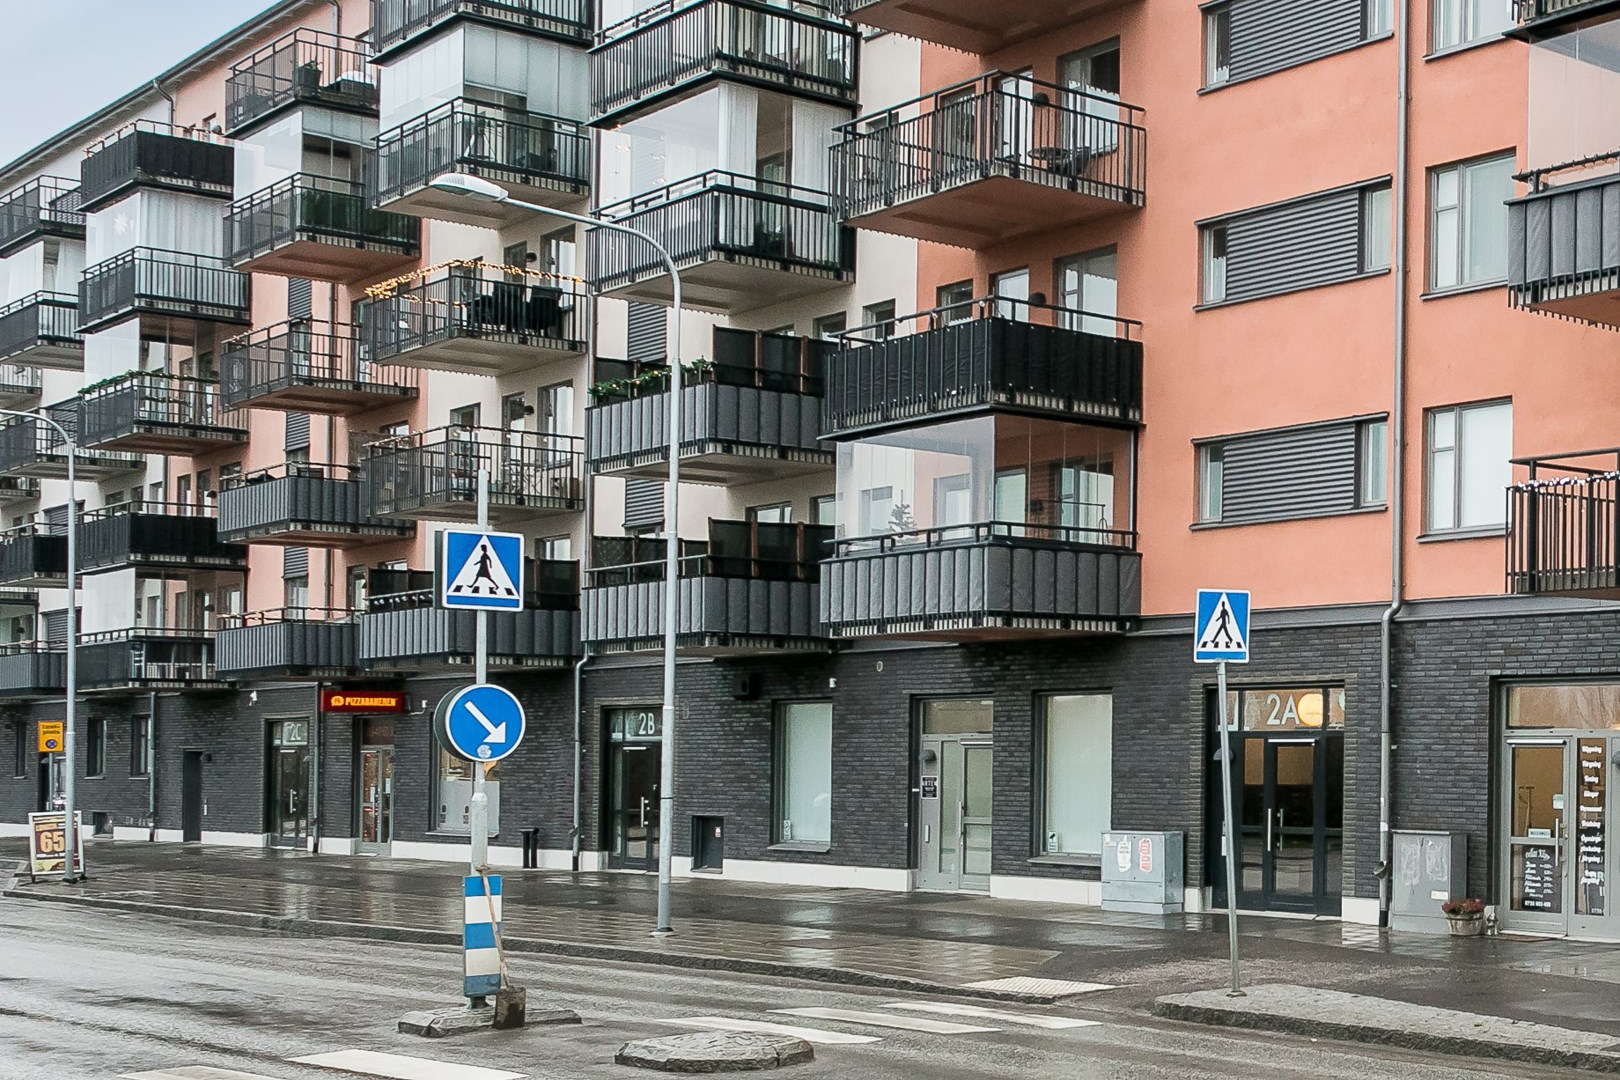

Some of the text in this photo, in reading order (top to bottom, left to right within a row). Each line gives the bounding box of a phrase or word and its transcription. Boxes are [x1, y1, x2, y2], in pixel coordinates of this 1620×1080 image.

[1266, 693, 1300, 725] 2A
[638, 712, 655, 735] 2B
[39, 830, 65, 853] 65
